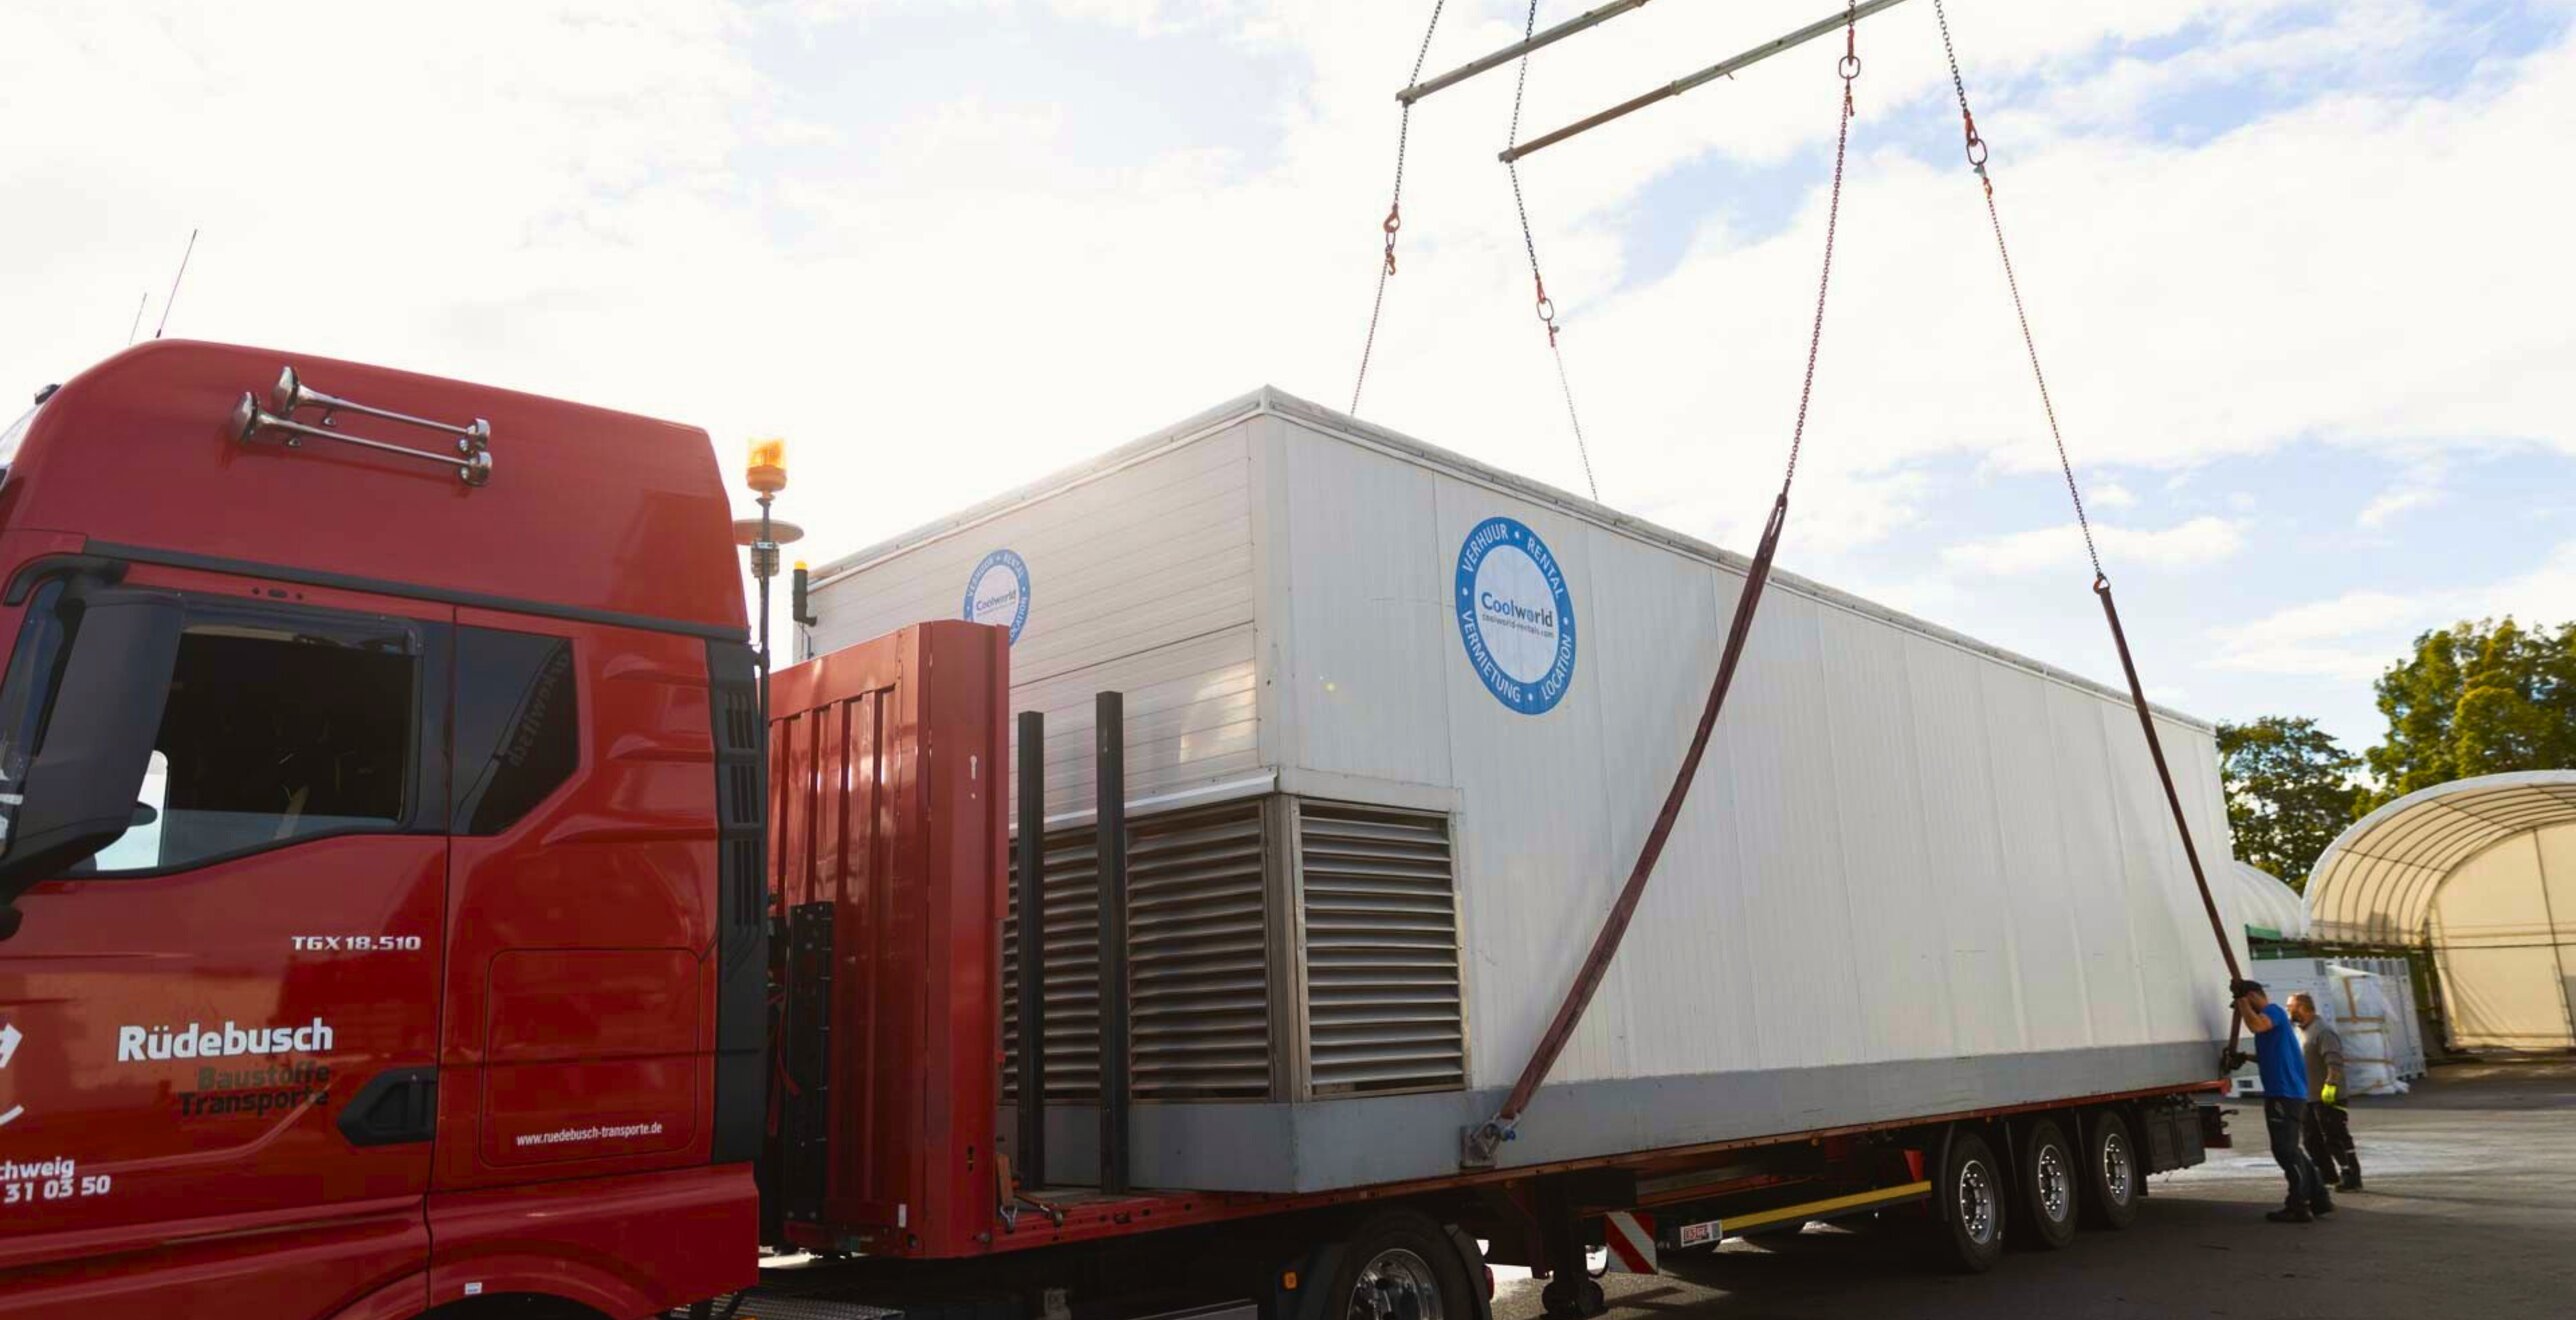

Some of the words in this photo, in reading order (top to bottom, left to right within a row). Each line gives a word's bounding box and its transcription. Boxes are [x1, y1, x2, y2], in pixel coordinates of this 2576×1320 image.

[1462, 523, 1508, 573] VERHUUR
[1527, 536, 1565, 599] RENTAL
[1481, 592, 1554, 627] Coolworld
[1461, 609, 1521, 703] VERMIETUNG
[1540, 634, 1572, 700] LOCATION
[291, 936, 341, 951] TGX
[345, 936, 422, 951] 18.510
[118, 1017, 333, 1062] Rüdebusch
[197, 1060, 331, 1090] Baustoffe
[178, 1086, 330, 1117] Transporte
[516, 1122, 663, 1146] www.ruedebusch-transporte.de
[43, 1178, 74, 1199] 03
[81, 1175, 111, 1196] 50
